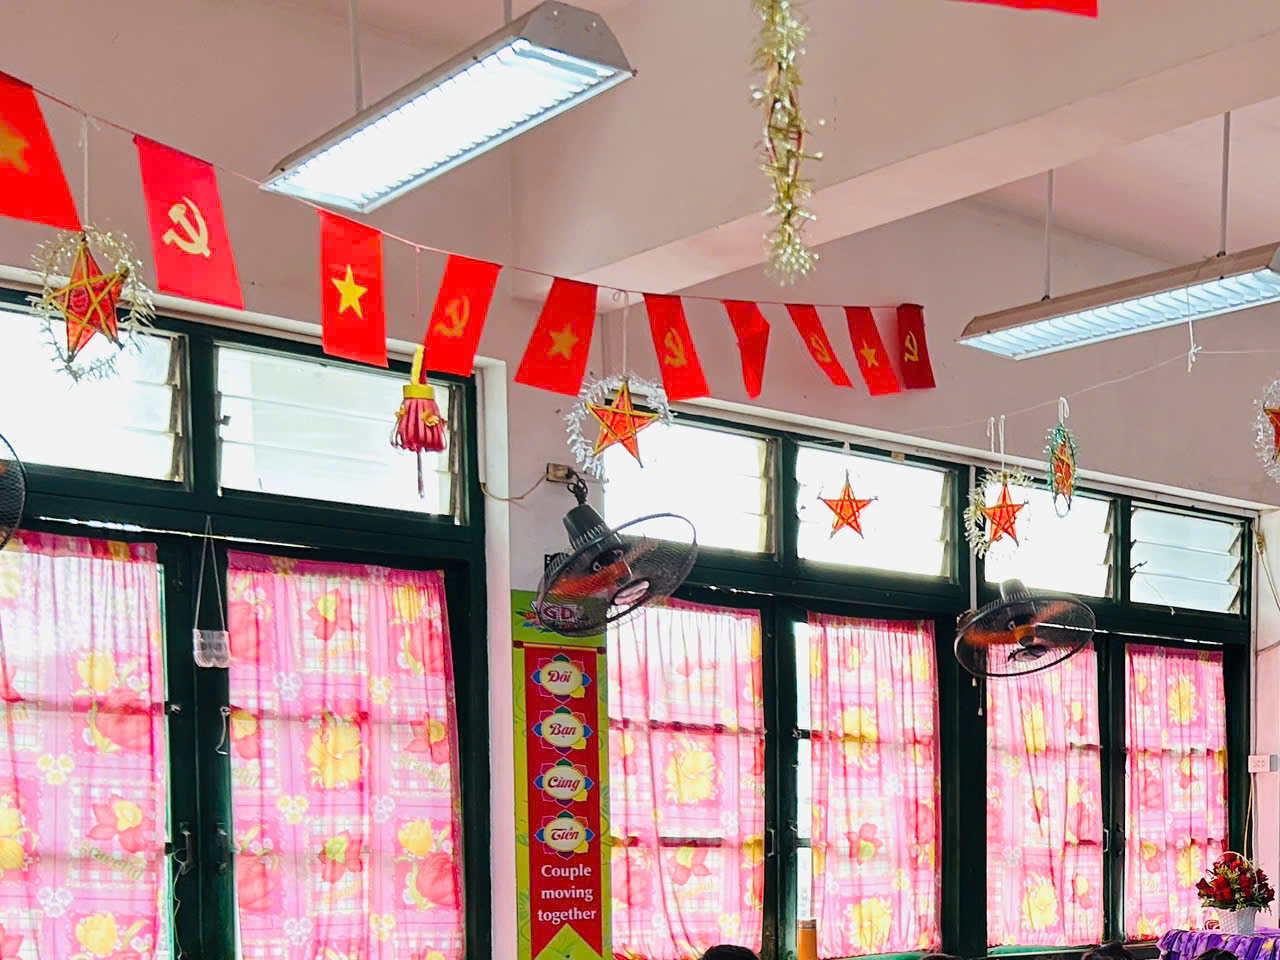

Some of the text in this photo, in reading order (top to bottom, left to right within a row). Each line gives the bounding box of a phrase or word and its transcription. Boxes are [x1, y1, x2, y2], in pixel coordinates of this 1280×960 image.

[548, 670, 572, 683] Đôi
[549, 723, 576, 738] Bạn
[547, 776, 581, 792] Cùng
[541, 863, 592, 880] Couple
[541, 886, 594, 902] moving
[537, 907, 597, 925] together
